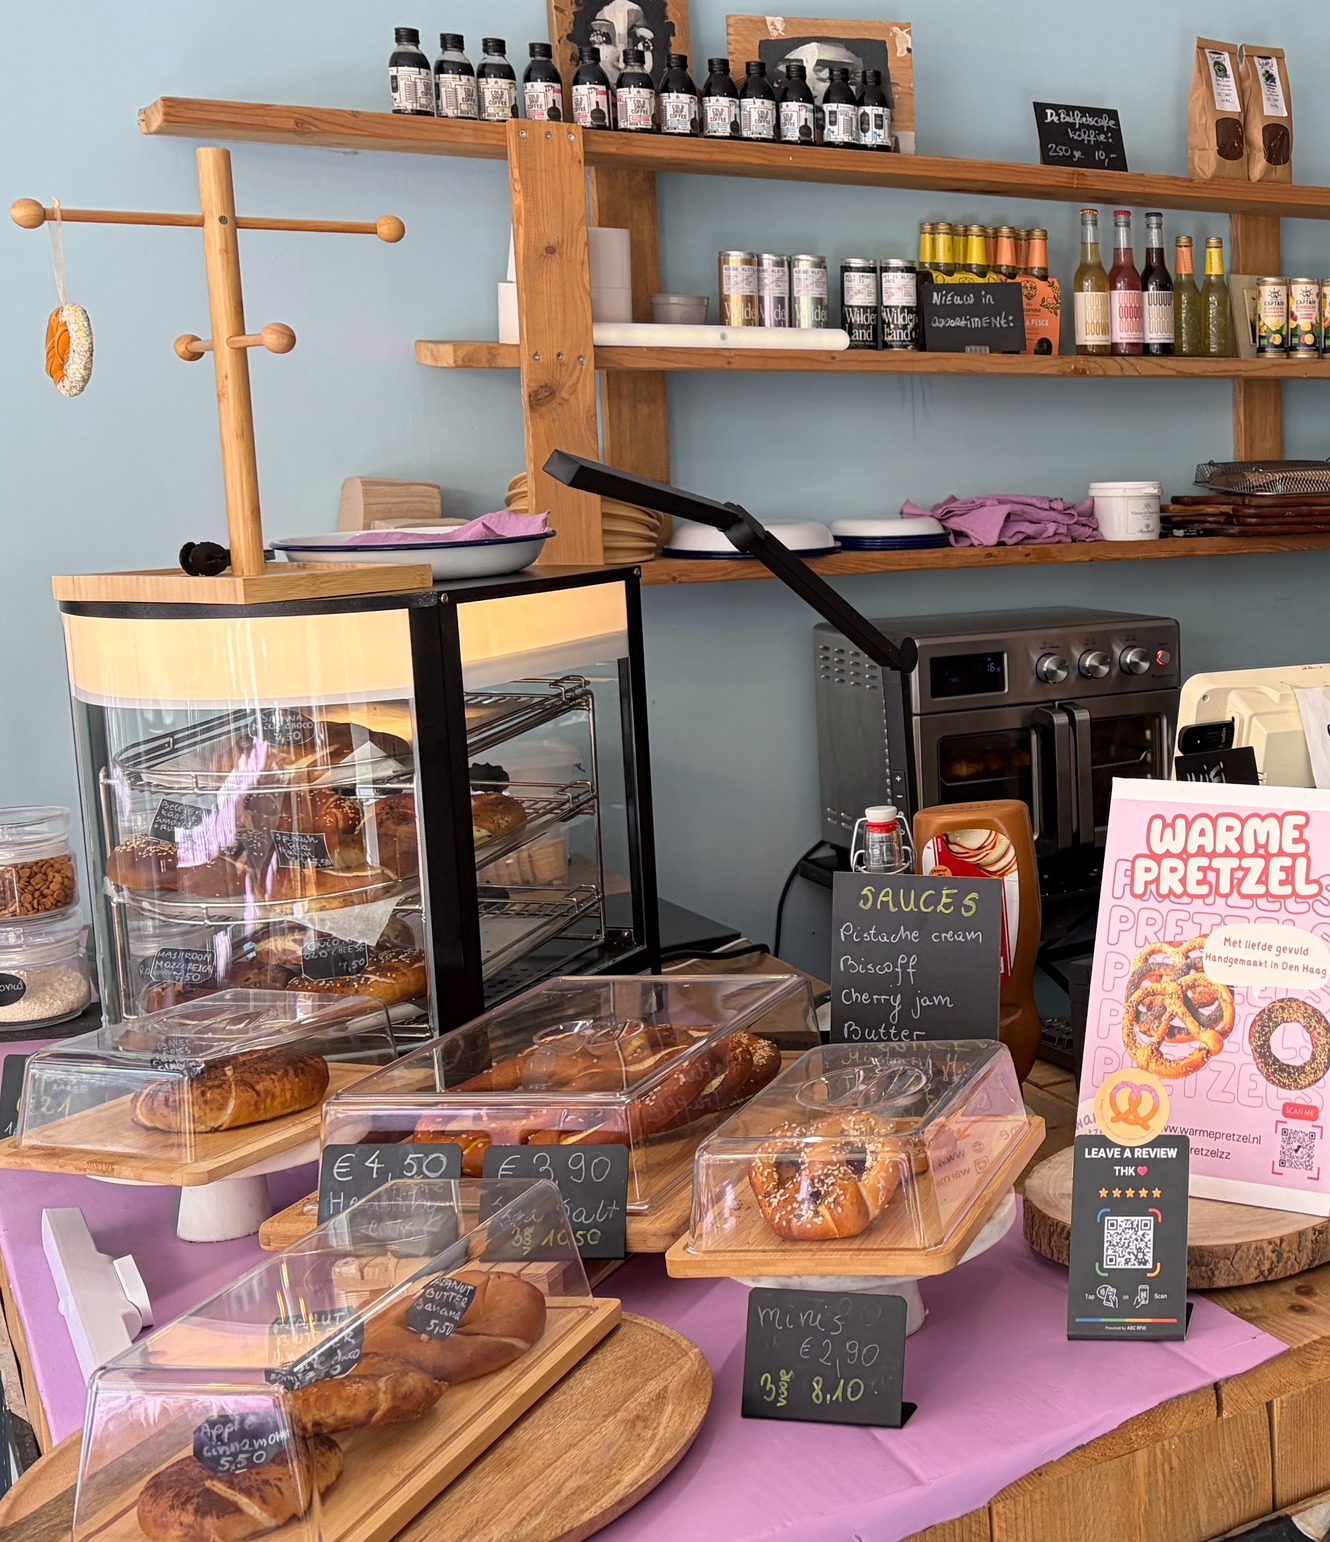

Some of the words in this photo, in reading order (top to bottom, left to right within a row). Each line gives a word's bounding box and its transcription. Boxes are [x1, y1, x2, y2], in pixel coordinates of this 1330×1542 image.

[1048, 143, 1071, 156] 250
[982, 291, 995, 304] in
[845, 307, 878, 325] Wilder
[883, 306, 916, 325] Wilder
[846, 324, 873, 341] Land
[884, 324, 911, 341] Land
[1147, 812, 1309, 855] WARME
[1131, 854, 1323, 899] PRETZEL
[859, 885, 980, 918] SAUCES
[839, 922, 920, 943] Pistache
[931, 930, 984, 944] cream
[1223, 936, 1244, 949] Met
[1244, 939, 1273, 952] liefde
[1275, 945, 1310, 958] gevuld
[839, 954, 918, 986] Biscoff
[1205, 952, 1268, 969] Handgemaakt
[1270, 960, 1279, 969] in
[1282, 961, 1301, 973] Den
[1302, 964, 1328, 979] Haag
[911, 990, 954, 1020] jam
[843, 1021, 926, 1042] Butter
[1285, 1107, 1303, 1116] SCAN
[1303, 1109, 1315, 1118] ME
[1161, 1124, 1261, 1145] ww.warmepretzel.nl
[1085, 1148, 1122, 1159] LEAVE
[1124, 1148, 1133, 1159] A
[1135, 1148, 1178, 1159] REVIEW
[1190, 1147, 1231, 1160] retzelzz
[1113, 1166, 1136, 1177] THK
[1085, 1292, 1095, 1301] Tap
[1154, 1292, 1168, 1300] Scan
[425, 1320, 455, 1336] 5,50
[758, 1305, 843, 1335] minis
[760, 1373, 776, 1401] 3
[811, 1376, 864, 1404] 8,10
